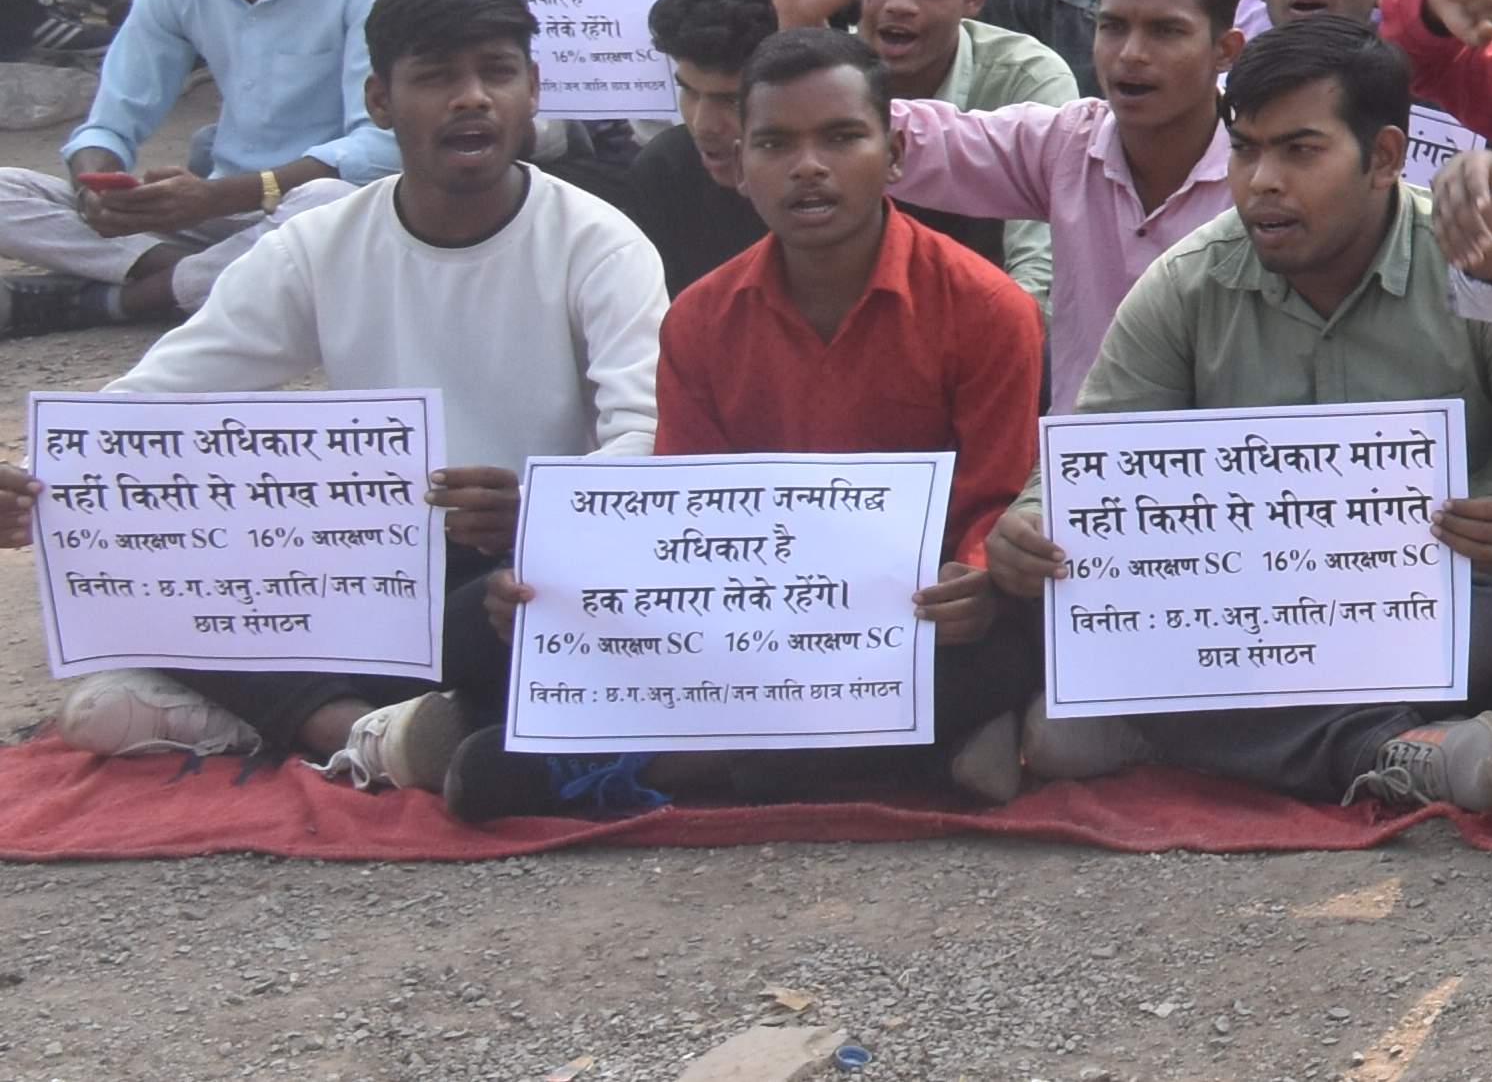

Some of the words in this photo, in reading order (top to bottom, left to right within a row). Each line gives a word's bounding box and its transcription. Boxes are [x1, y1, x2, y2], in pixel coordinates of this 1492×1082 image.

[46, 428, 88, 460] हम
[97, 429, 184, 458] अपना
[193, 418, 321, 461] अधिकार
[326, 416, 415, 456] मांगते
[1059, 450, 1108, 486] हम
[1116, 449, 1206, 479] अपना
[1214, 433, 1345, 477] अधिकार
[1348, 429, 1437, 472] मांगते
[51, 474, 108, 513] नहीं
[117, 472, 200, 510] किसी
[208, 473, 236, 511] से
[246, 471, 319, 508] भीख
[328, 471, 413, 507] मांगते
[570, 489, 679, 519] आरक्षण
[686, 487, 766, 517] हमारा
[773, 477, 892, 513] जन्मसिद्ध
[1068, 496, 1128, 540] नहीं
[1135, 493, 1218, 534] किसी
[1226, 492, 1256, 531] से
[1266, 490, 1338, 529] भीख
[1345, 486, 1434, 525] मांगते
[53, 529, 109, 550] 16%
[115, 532, 186, 552] आरक्षण
[191, 527, 228, 549] SC
[248, 527, 304, 549] 16%
[311, 528, 384, 548] आरक्षण
[389, 524, 420, 547] SC
[653, 527, 768, 566] अधिकार
[773, 524, 797, 564] है
[66, 571, 135, 599] विनीत
[372, 569, 418, 599] जाति
[581, 587, 626, 617] हक
[634, 586, 716, 617] हमारा
[722, 576, 776, 615] लेके
[193, 614, 236, 634] छात्र
[242, 608, 312, 635] संगठन
